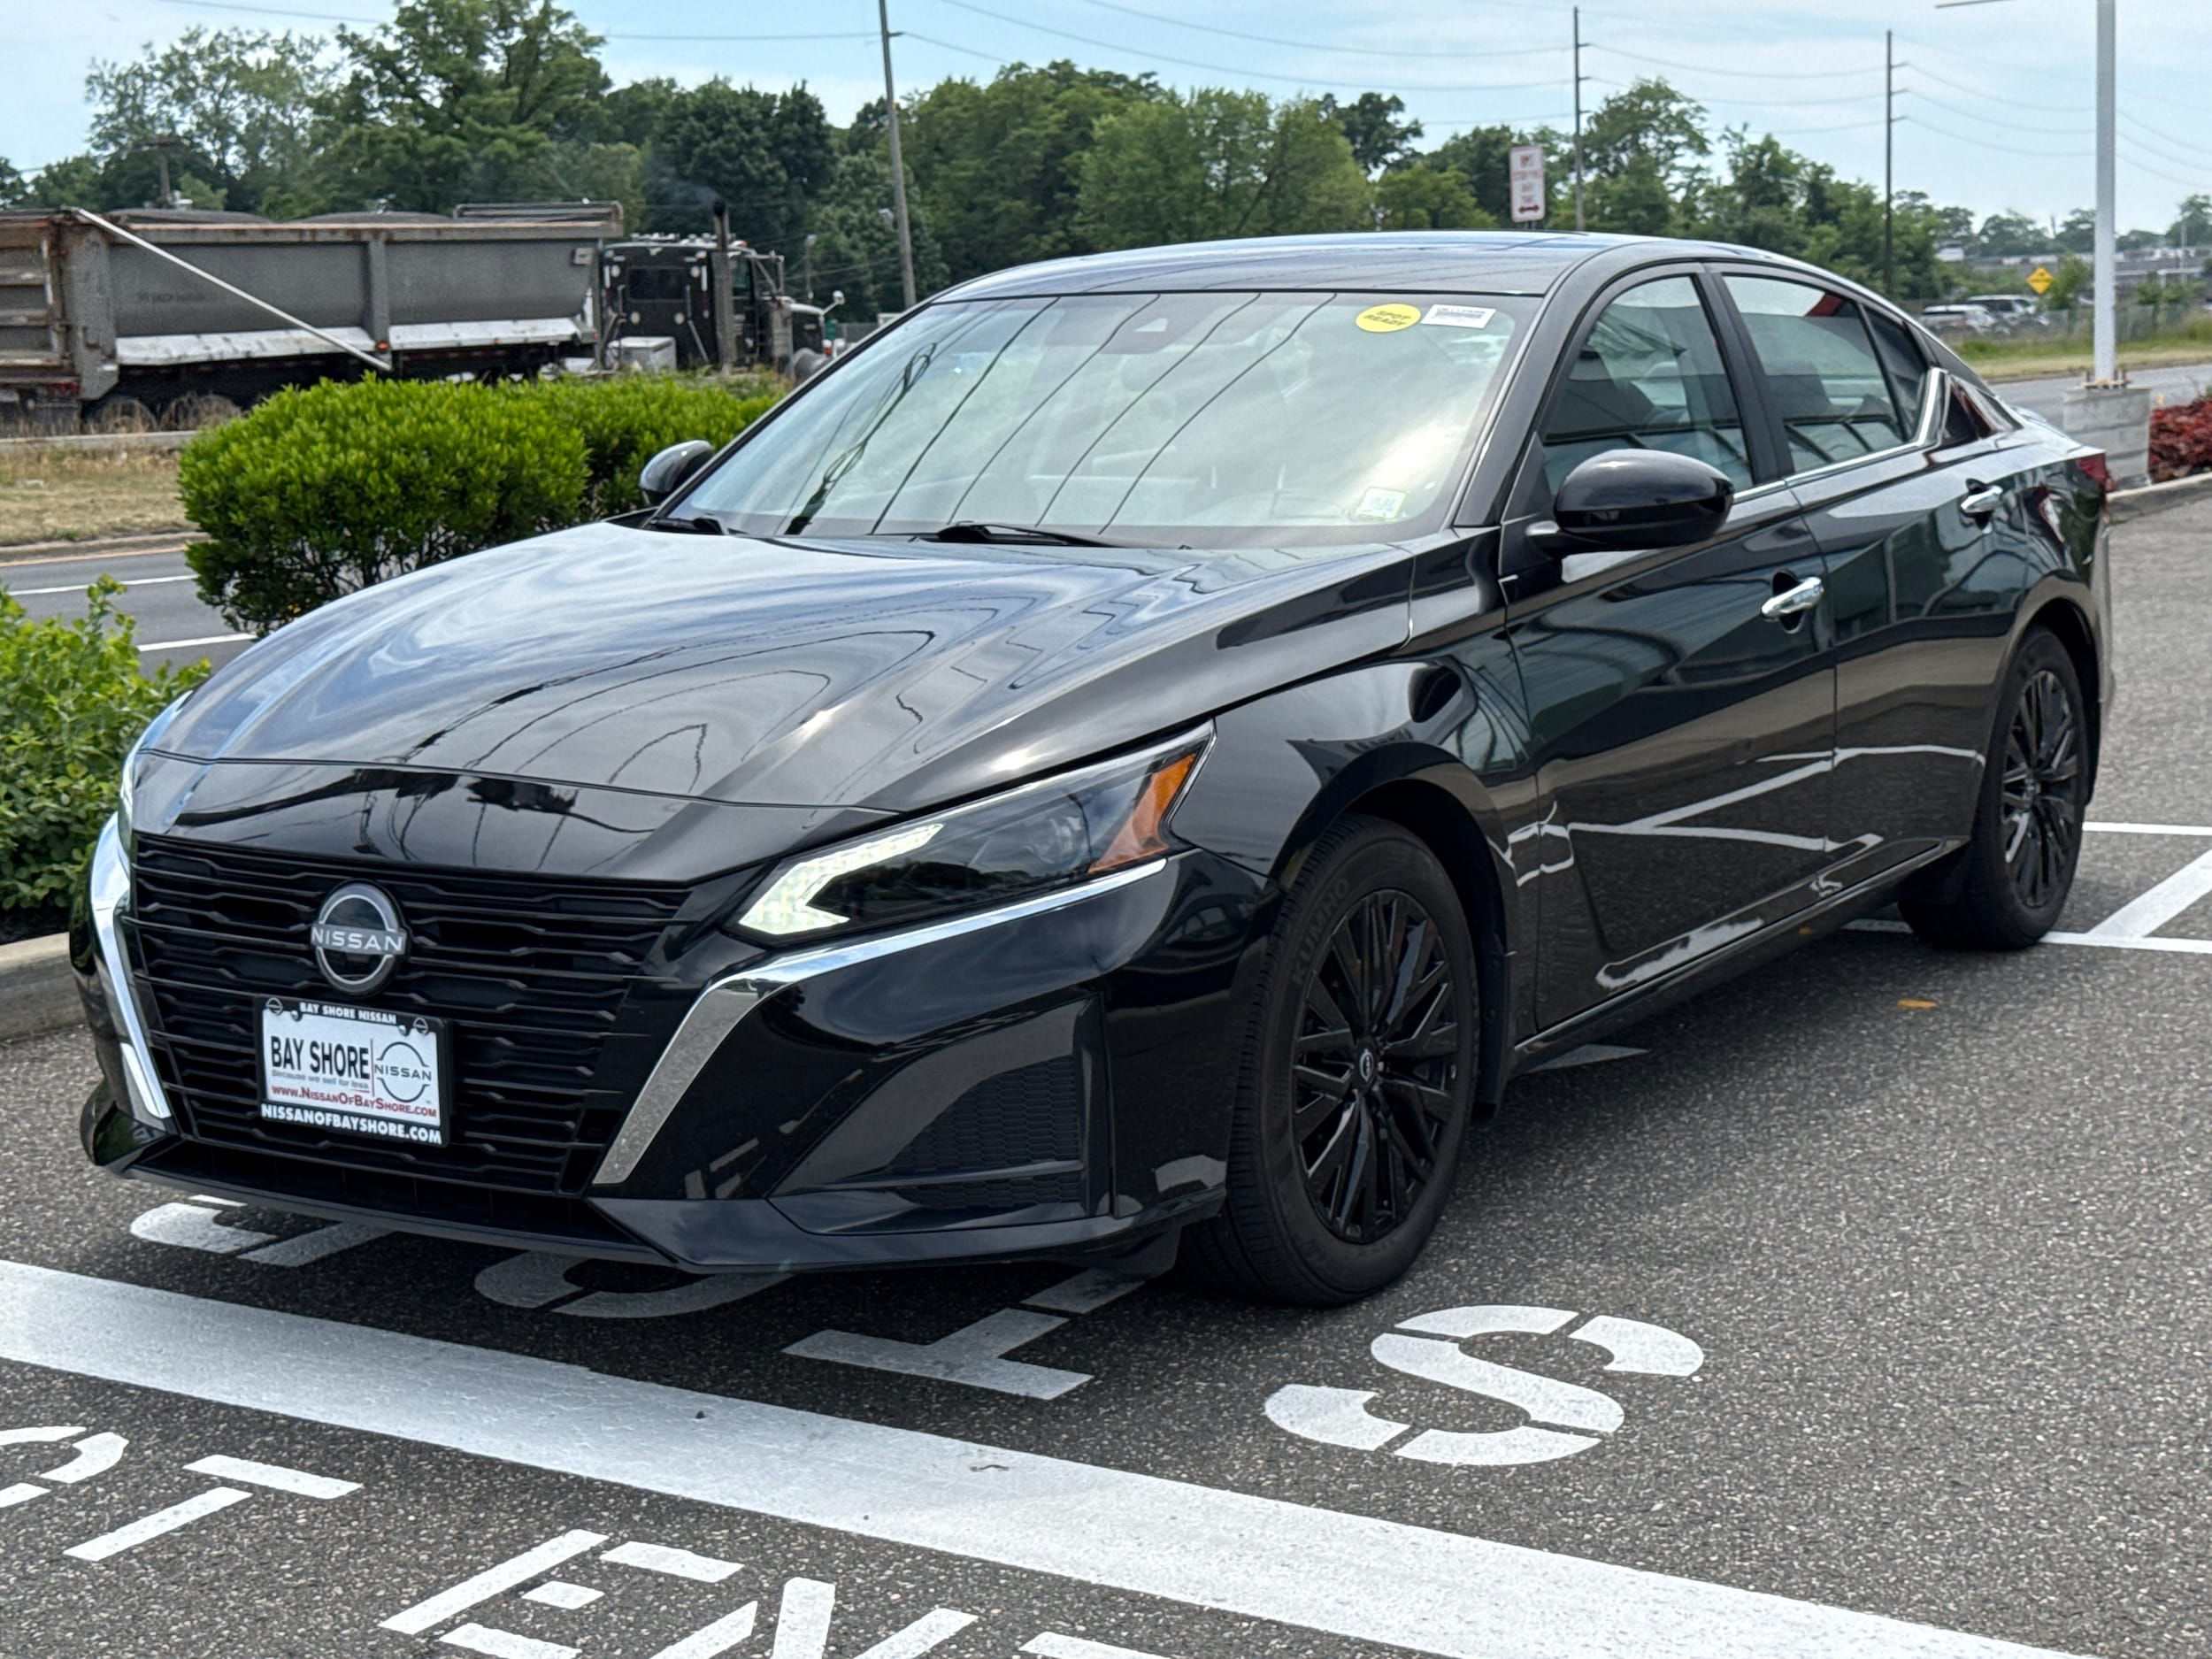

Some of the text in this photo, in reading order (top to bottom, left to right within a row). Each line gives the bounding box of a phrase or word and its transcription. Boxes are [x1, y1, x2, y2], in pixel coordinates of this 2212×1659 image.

[311, 926, 403, 952] NISSAN
[1292, 877, 1349, 986] KUMHO
[299, 1002, 397, 1025] BAY SHORE NISSAN
[271, 1035, 371, 1079] BAY SHORE
[374, 1064, 432, 1081] NISSAN
[260, 1102, 442, 1144] NISSANOFBAYSHORE.COM
